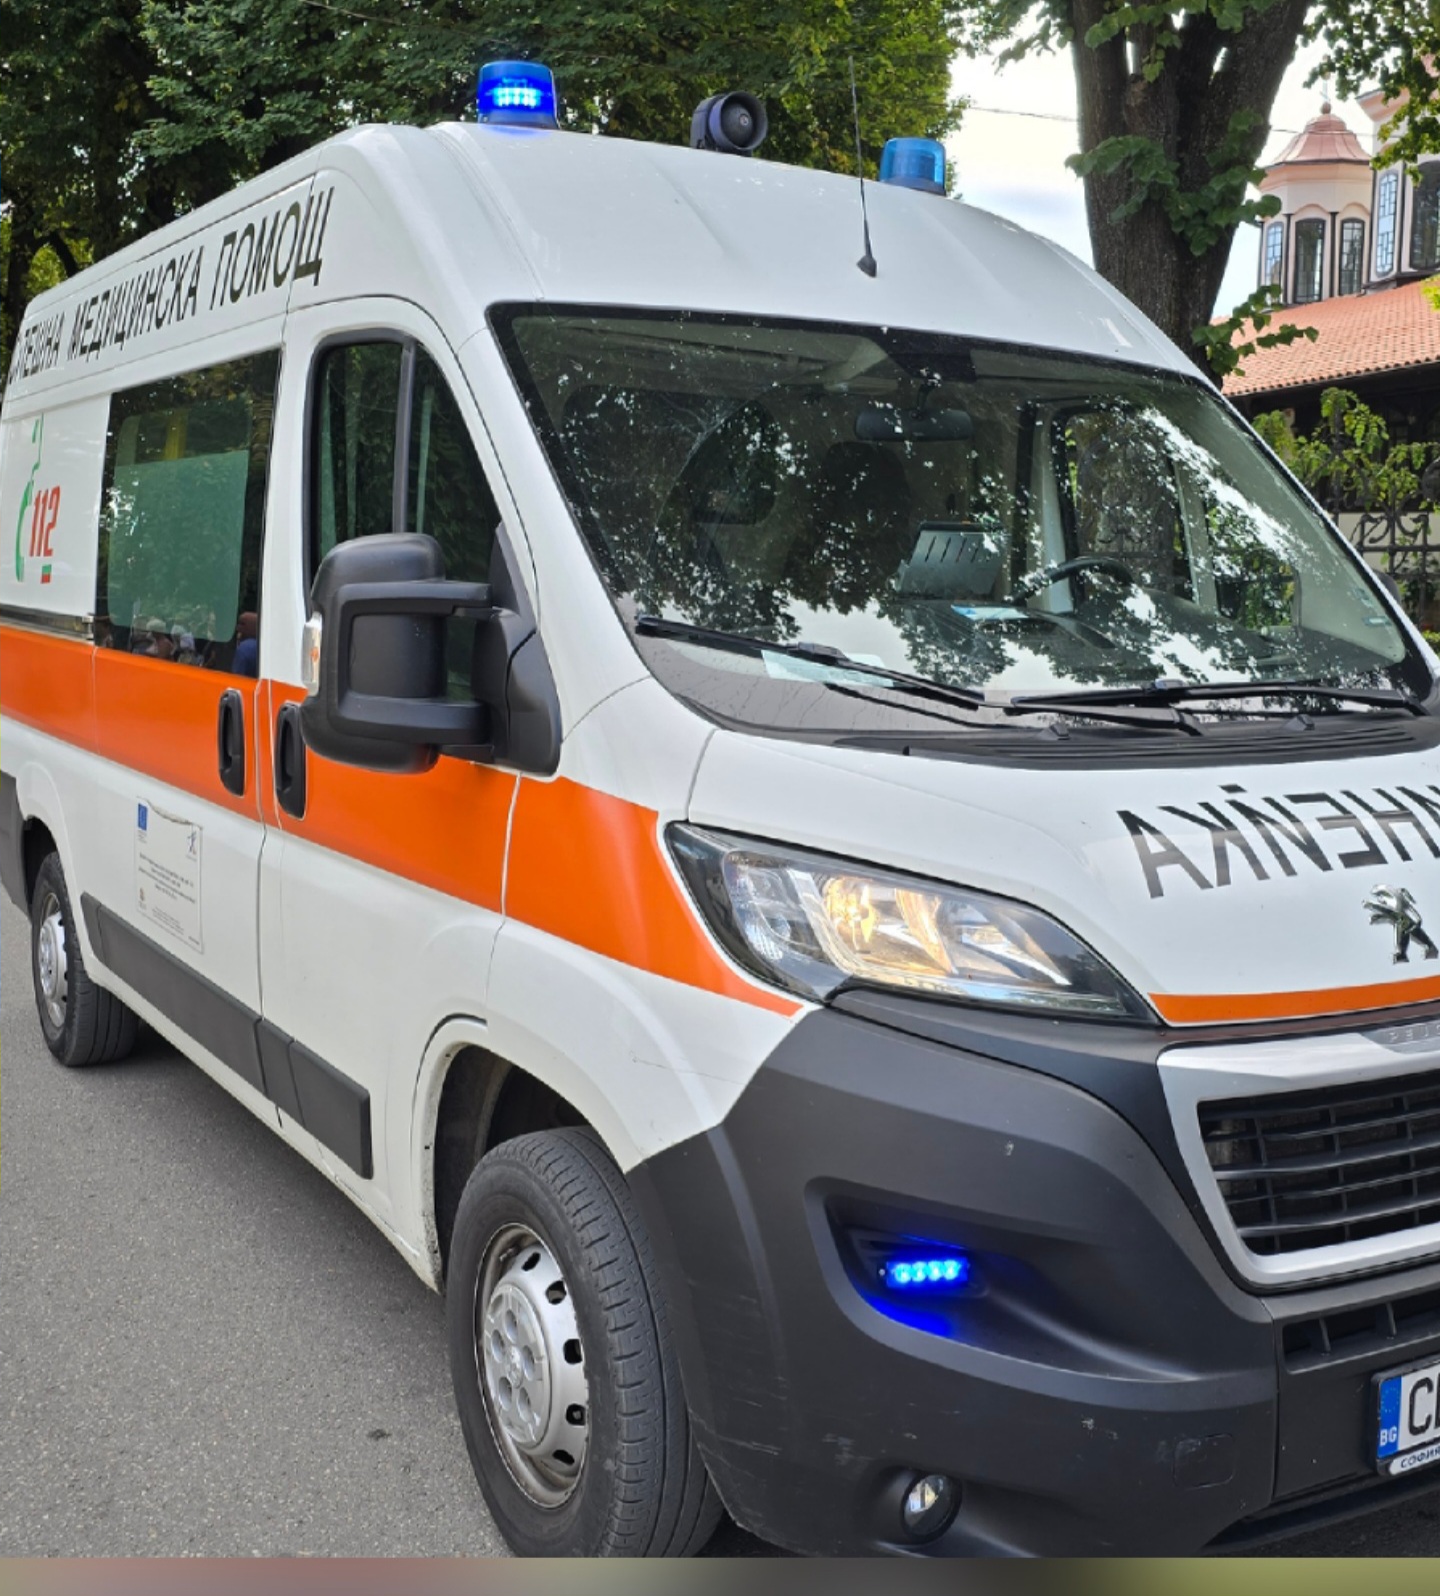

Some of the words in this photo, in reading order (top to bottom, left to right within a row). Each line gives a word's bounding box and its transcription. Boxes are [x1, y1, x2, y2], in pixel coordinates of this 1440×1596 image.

[67, 245, 204, 363] МЕДИЦИНСКА
[210, 186, 335, 311] ПОМОЩ
[29, 485, 60, 557] 112
[1380, 1426, 1398, 1447] BG
